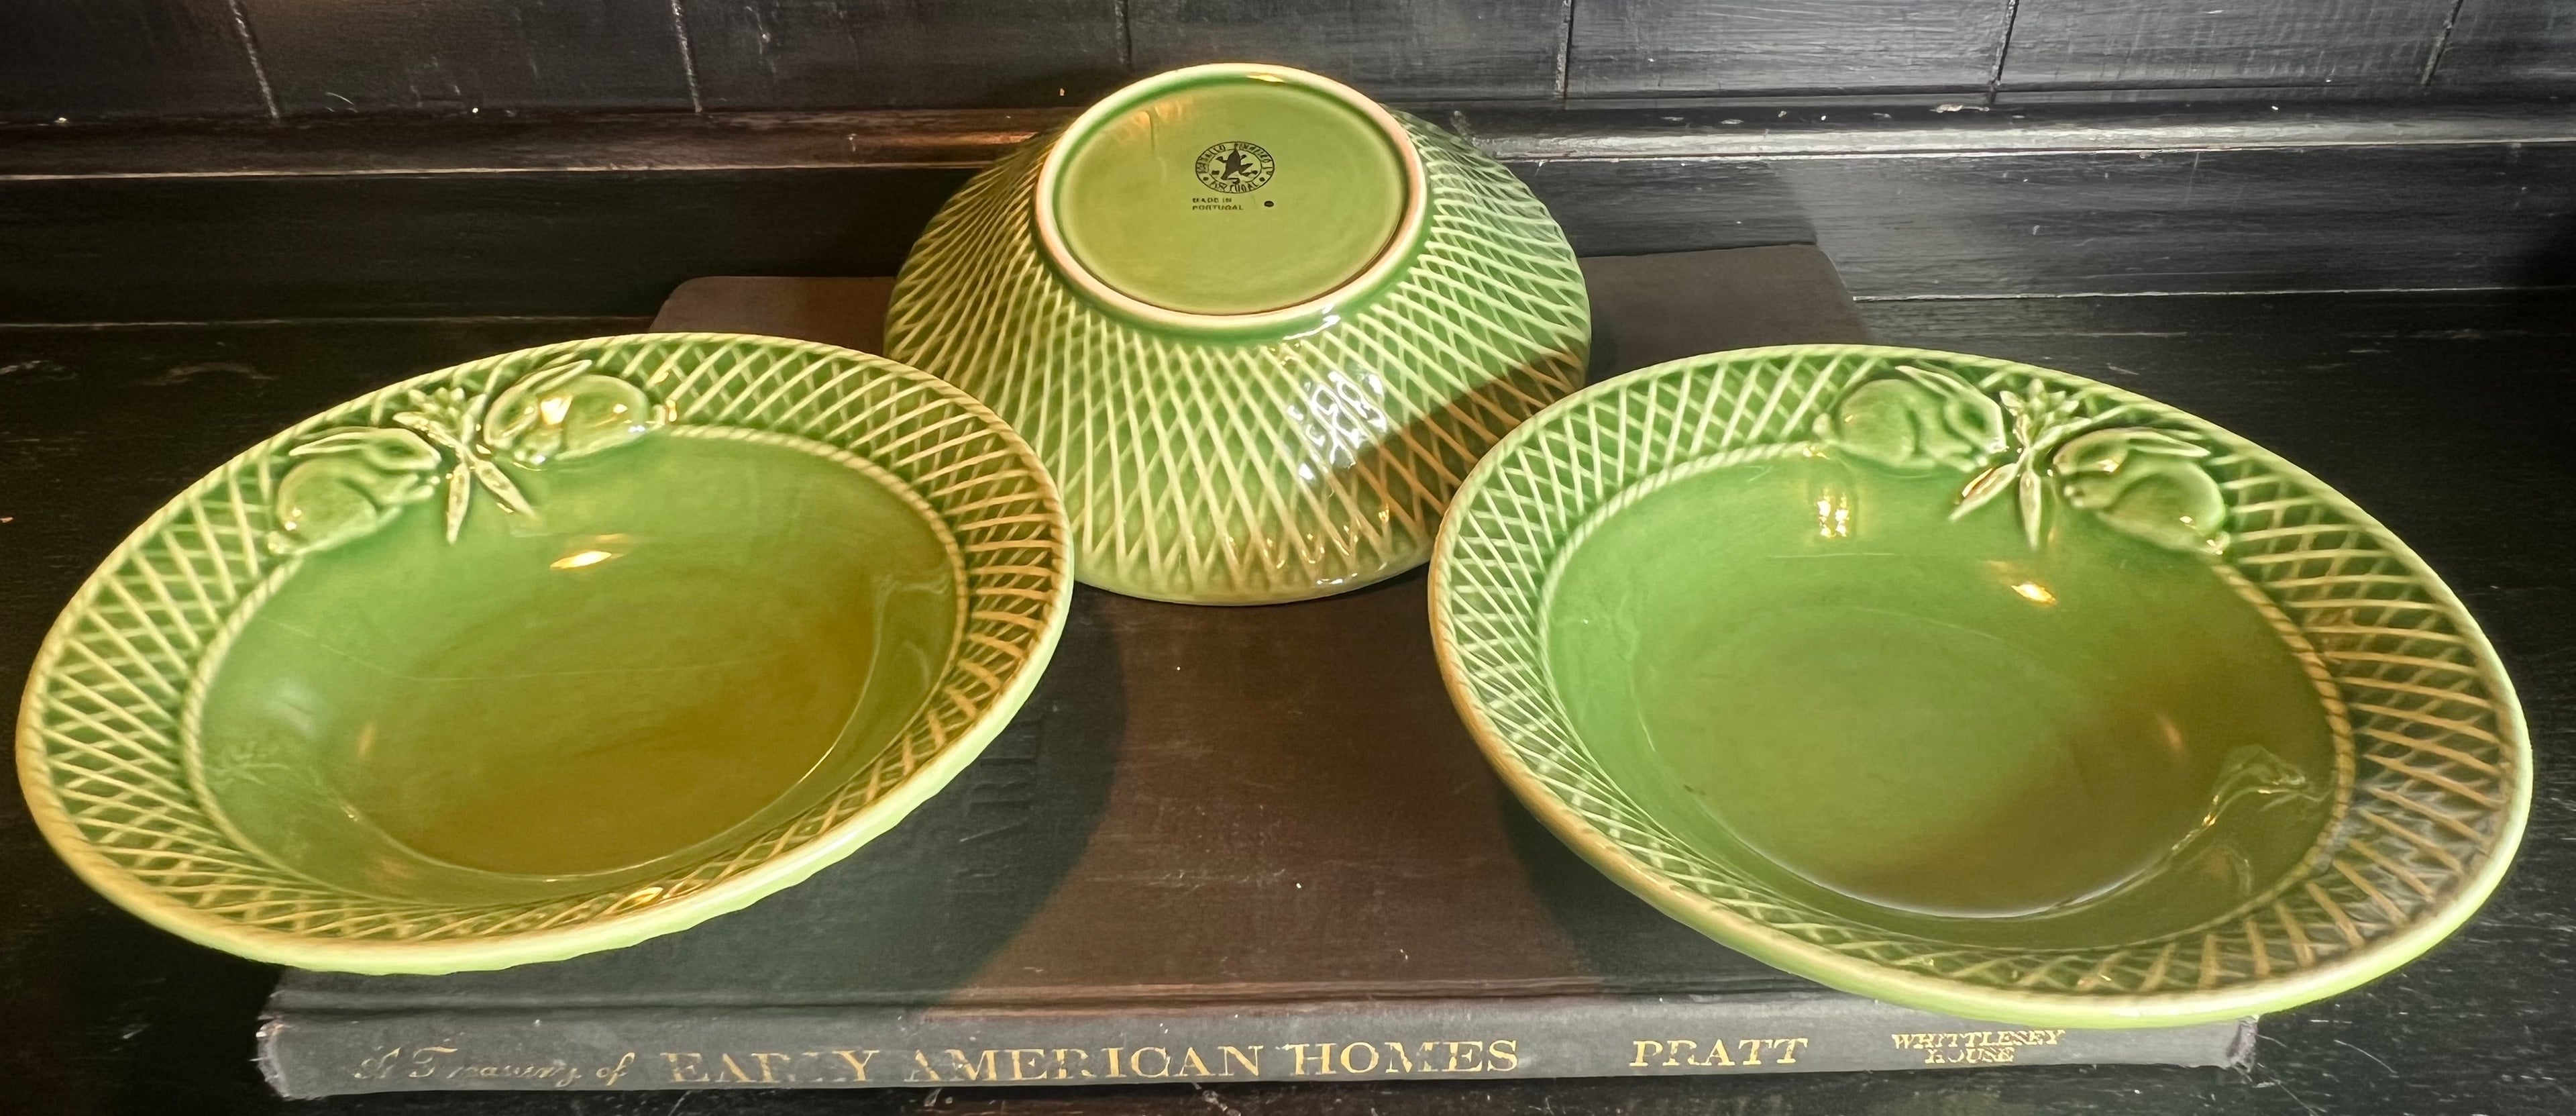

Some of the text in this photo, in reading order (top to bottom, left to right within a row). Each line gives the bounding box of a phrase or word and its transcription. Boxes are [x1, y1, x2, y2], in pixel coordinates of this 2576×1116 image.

[1629, 1037, 1809, 1066] PRATT
[1891, 1029, 2066, 1050] WHITTLESEY
[596, 1052, 636, 1086] of
[903, 1046, 1265, 1082] AMERICAN
[1279, 1039, 1519, 1076] HOMES
[1924, 1046, 2015, 1064] HOUSE
